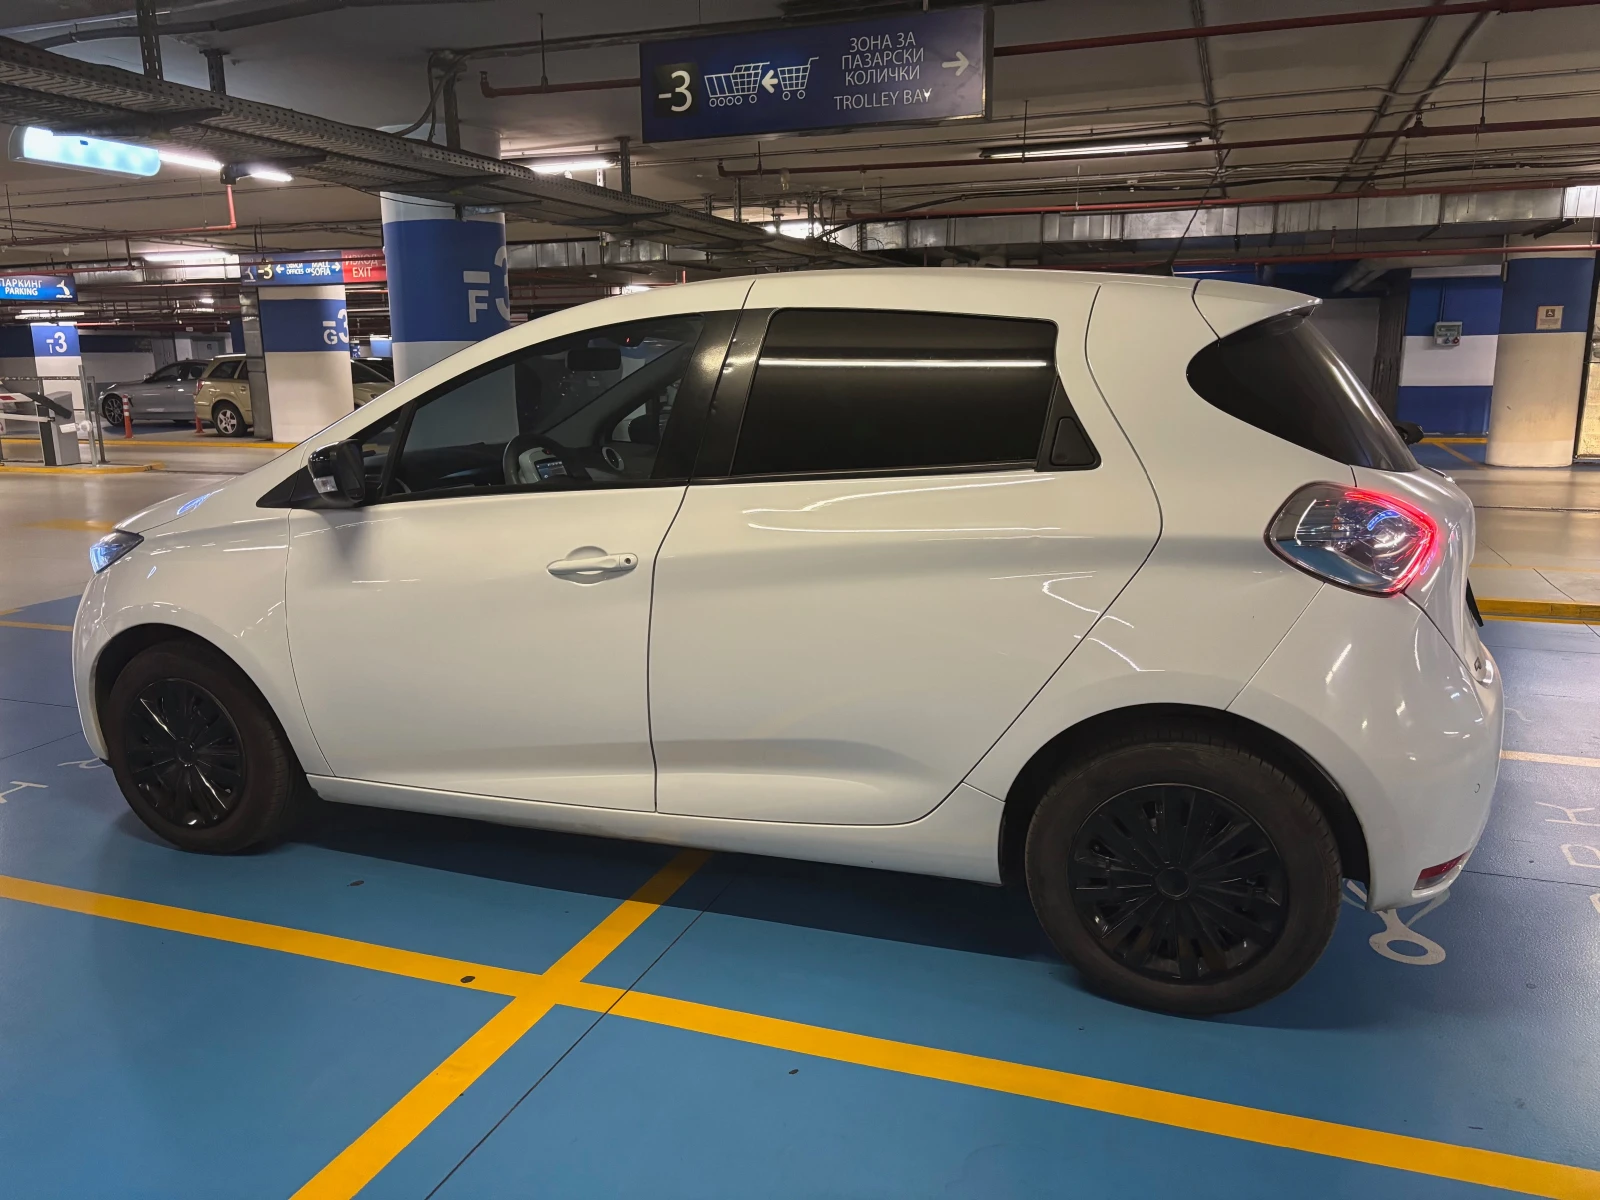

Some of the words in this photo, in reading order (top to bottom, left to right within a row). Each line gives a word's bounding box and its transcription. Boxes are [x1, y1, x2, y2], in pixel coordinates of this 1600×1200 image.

[850, 34, 892, 52] ЗОНА
[896, 31, 916, 48] ЗА
[841, 47, 925, 70] ПАЗАРСКИ
[845, 65, 920, 86] КОЛИЧКИ
[658, 70, 693, 112] -3
[834, 91, 900, 111] TROLLEY
[903, 88, 932, 105] BAY
[311, 267, 331, 277] SOFIA
[352, 266, 372, 278] EXIT
[5, 287, 38, 296] PARKING
